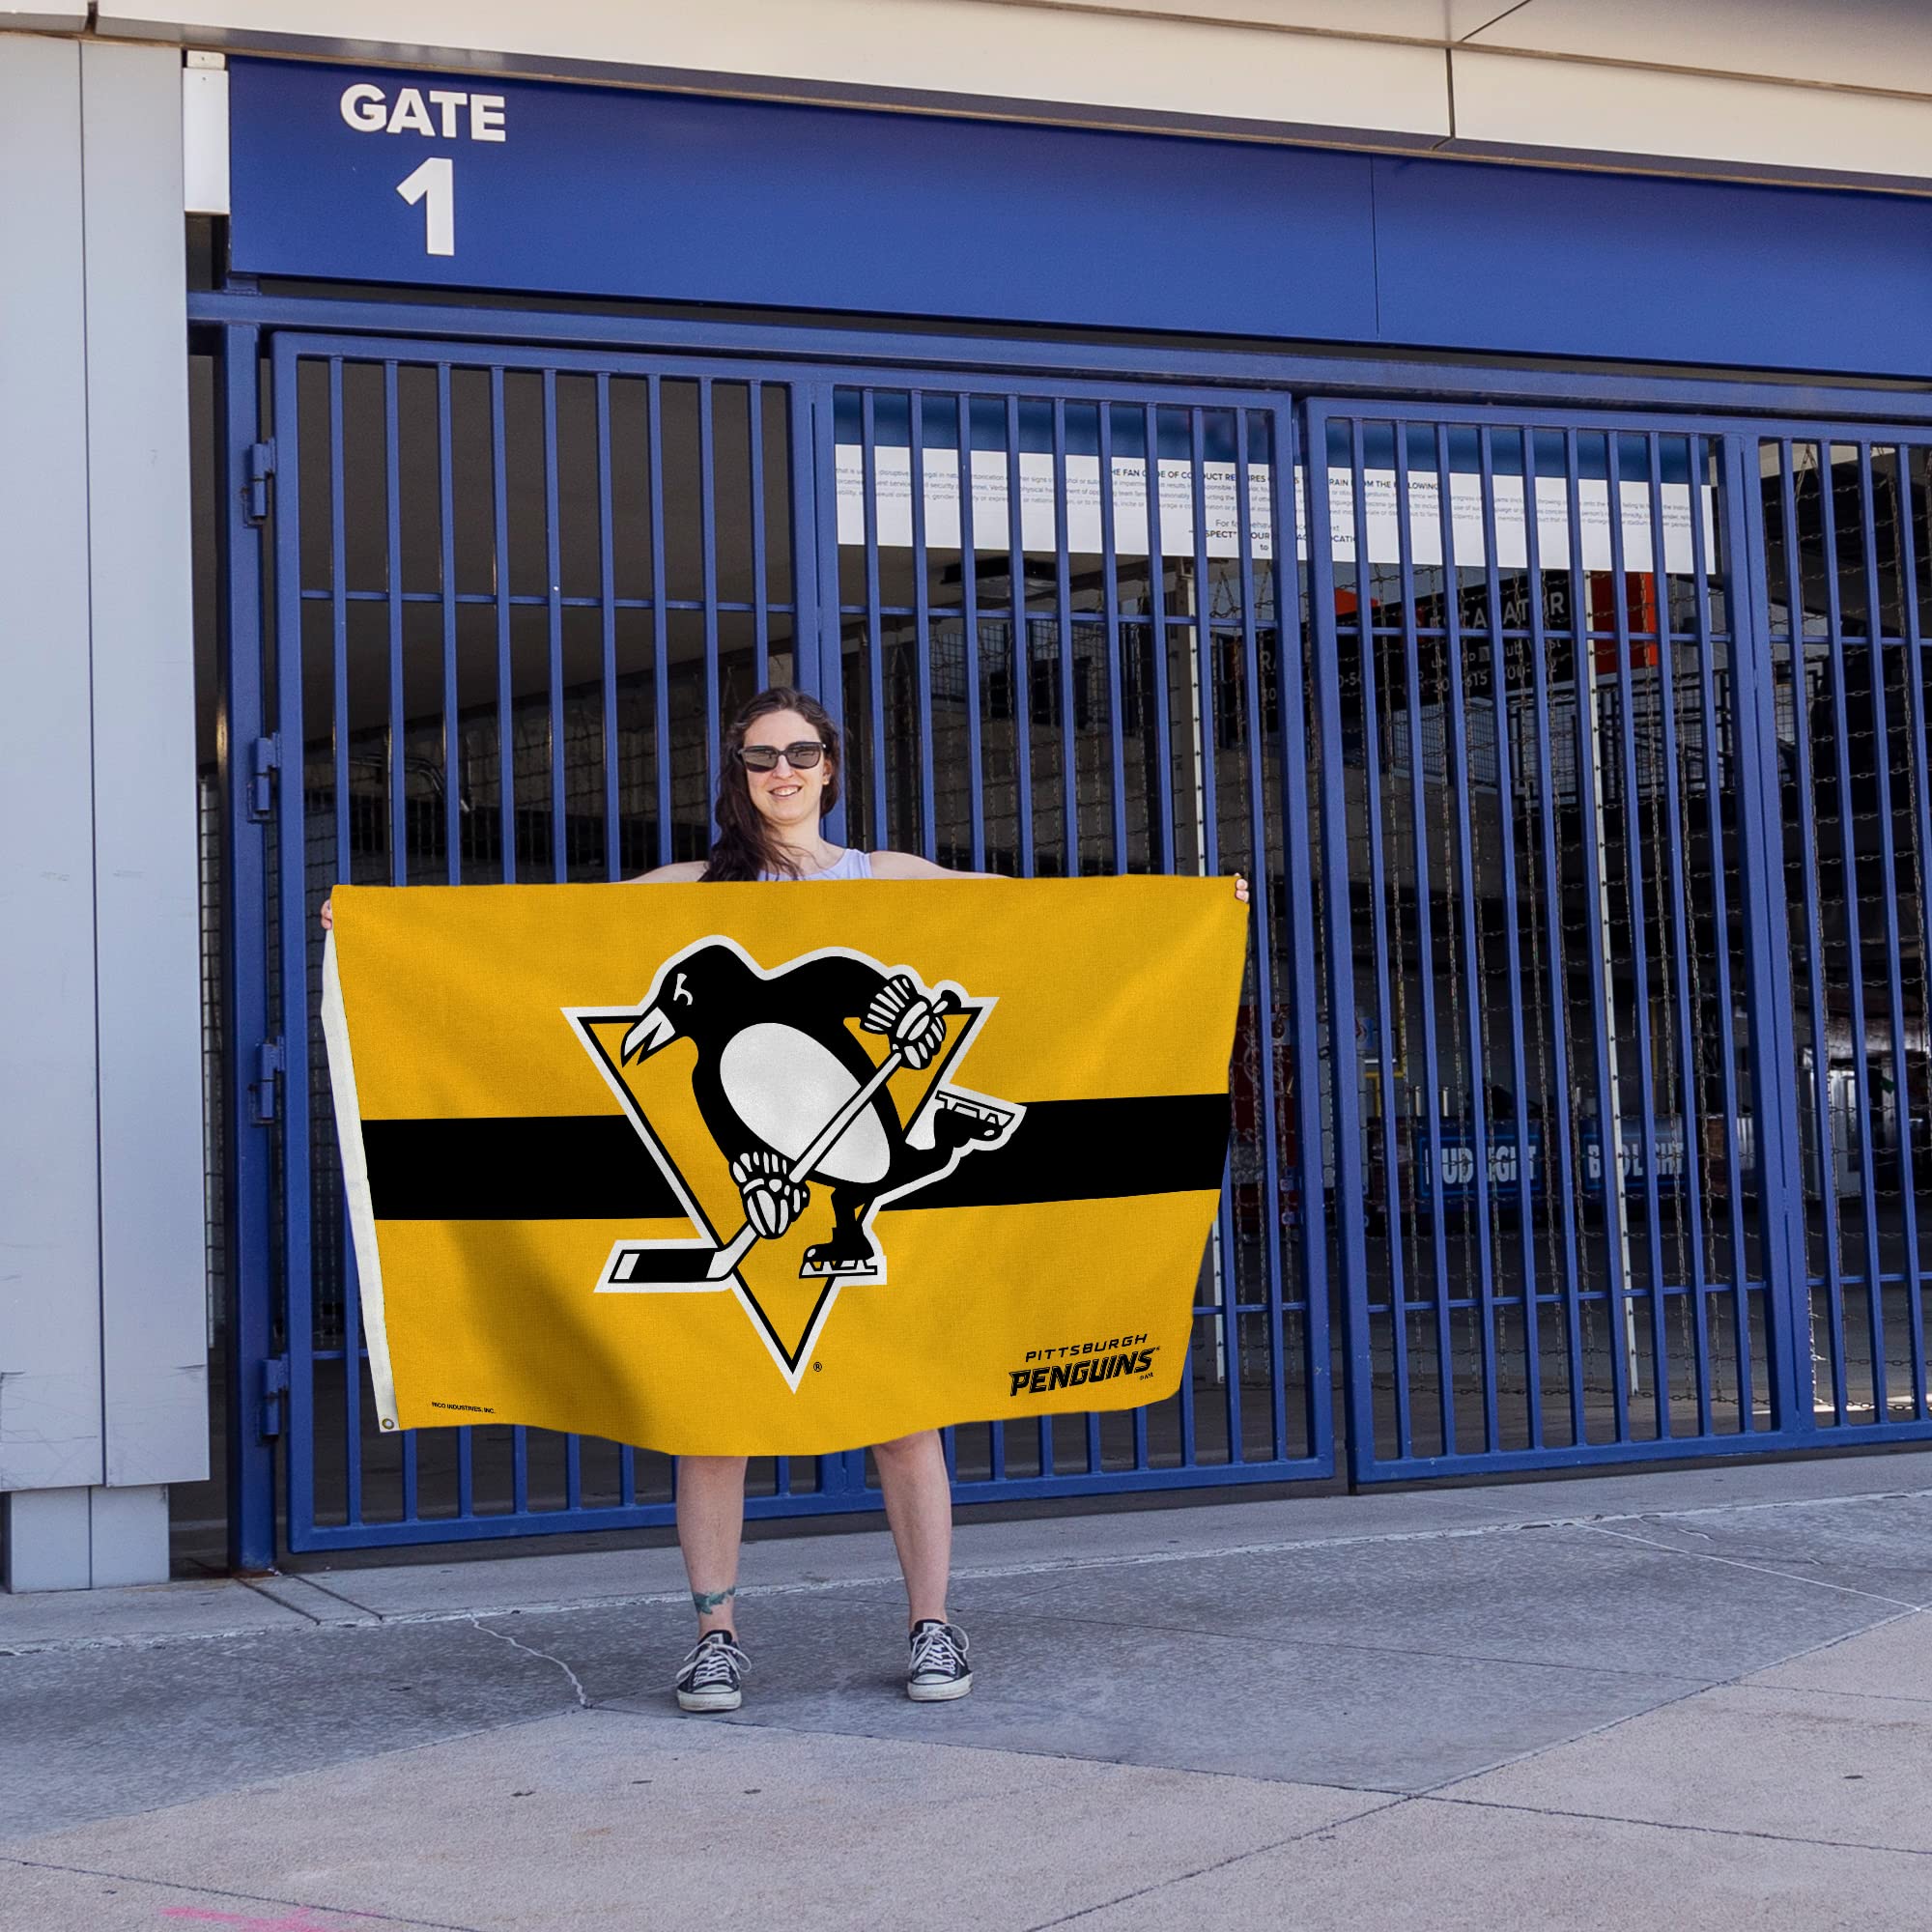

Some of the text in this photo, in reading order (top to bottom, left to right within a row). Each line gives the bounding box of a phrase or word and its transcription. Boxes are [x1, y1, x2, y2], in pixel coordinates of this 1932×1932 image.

[341, 83, 506, 142] GATE
[396, 157, 454, 256] 1
[1215, 519, 1230, 527] For
[1260, 542, 1269, 552] to
[1025, 1333, 1148, 1363] PITTSBURGH
[1009, 1347, 1156, 1397] PENGUINS
